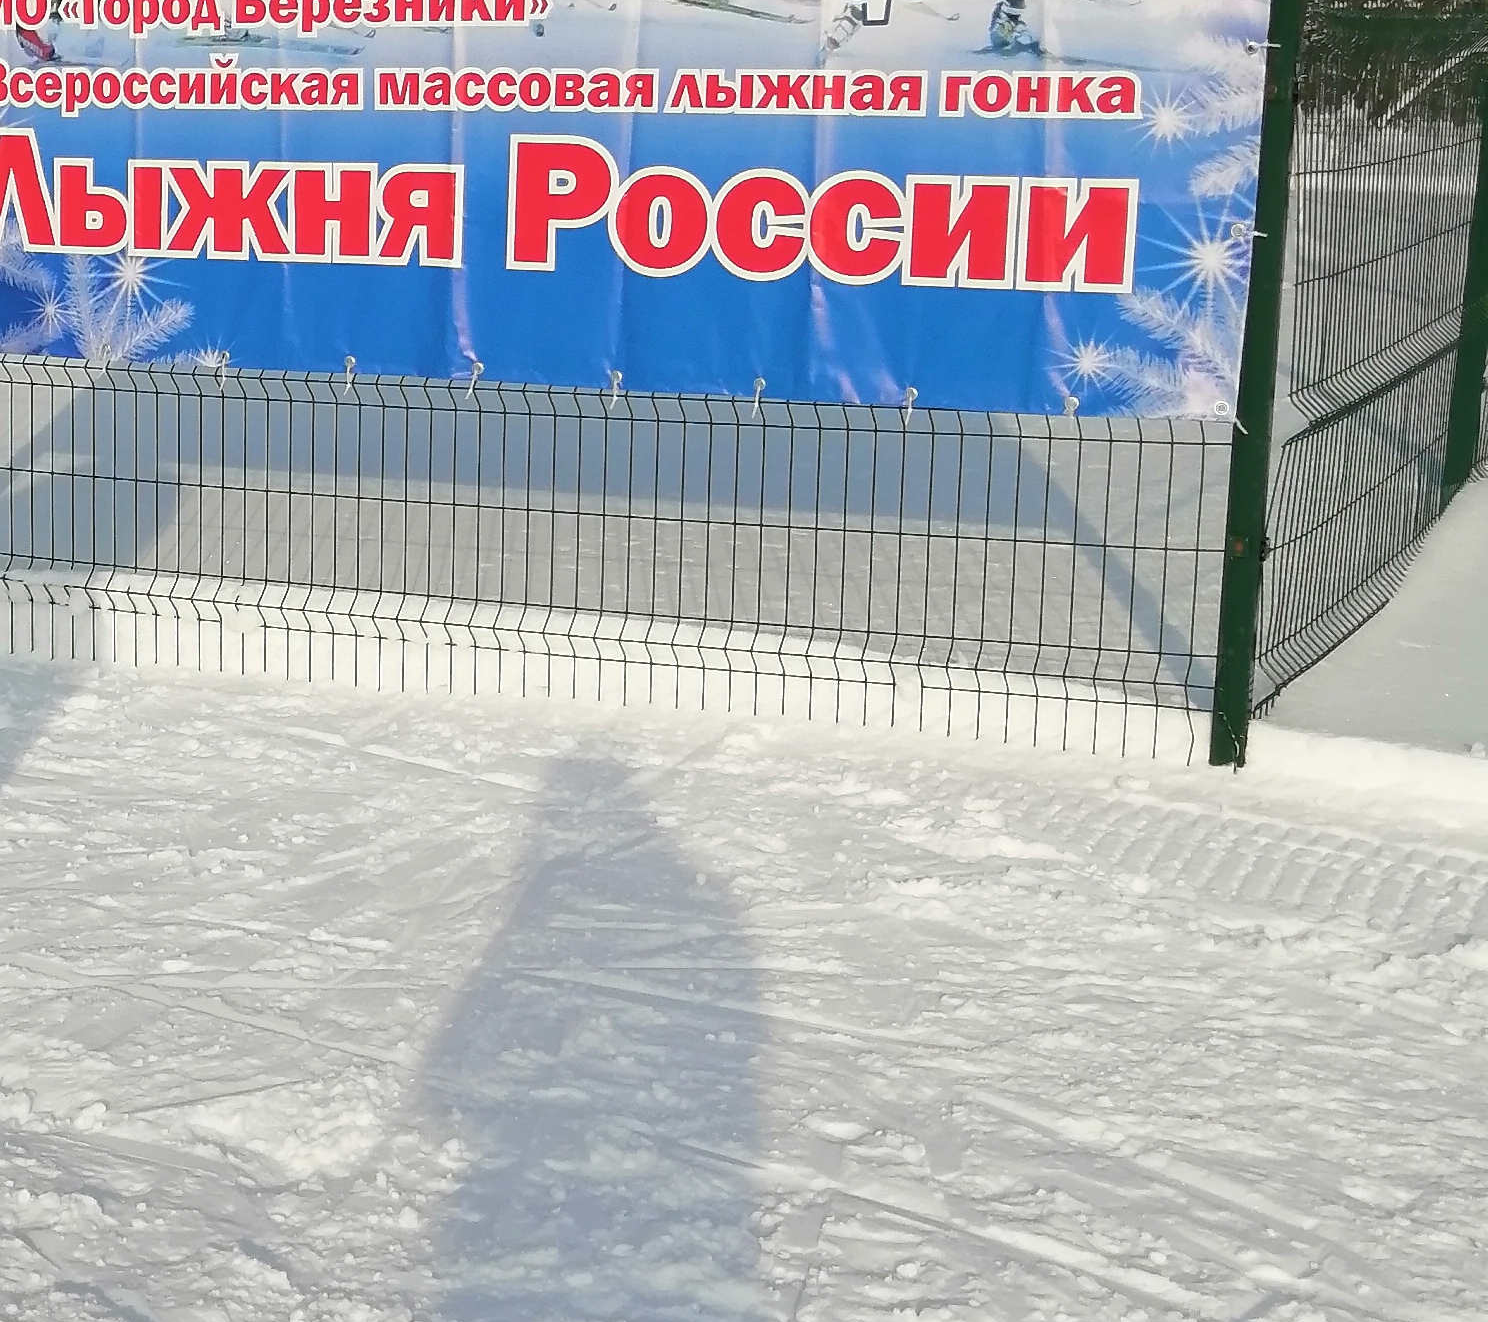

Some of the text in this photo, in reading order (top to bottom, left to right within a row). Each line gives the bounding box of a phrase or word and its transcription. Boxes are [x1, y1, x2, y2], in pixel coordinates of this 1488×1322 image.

[379, 70, 654, 110] массовая
[670, 72, 911, 114] лыжная
[944, 73, 1137, 115] гонка
[513, 141, 1131, 287] России
